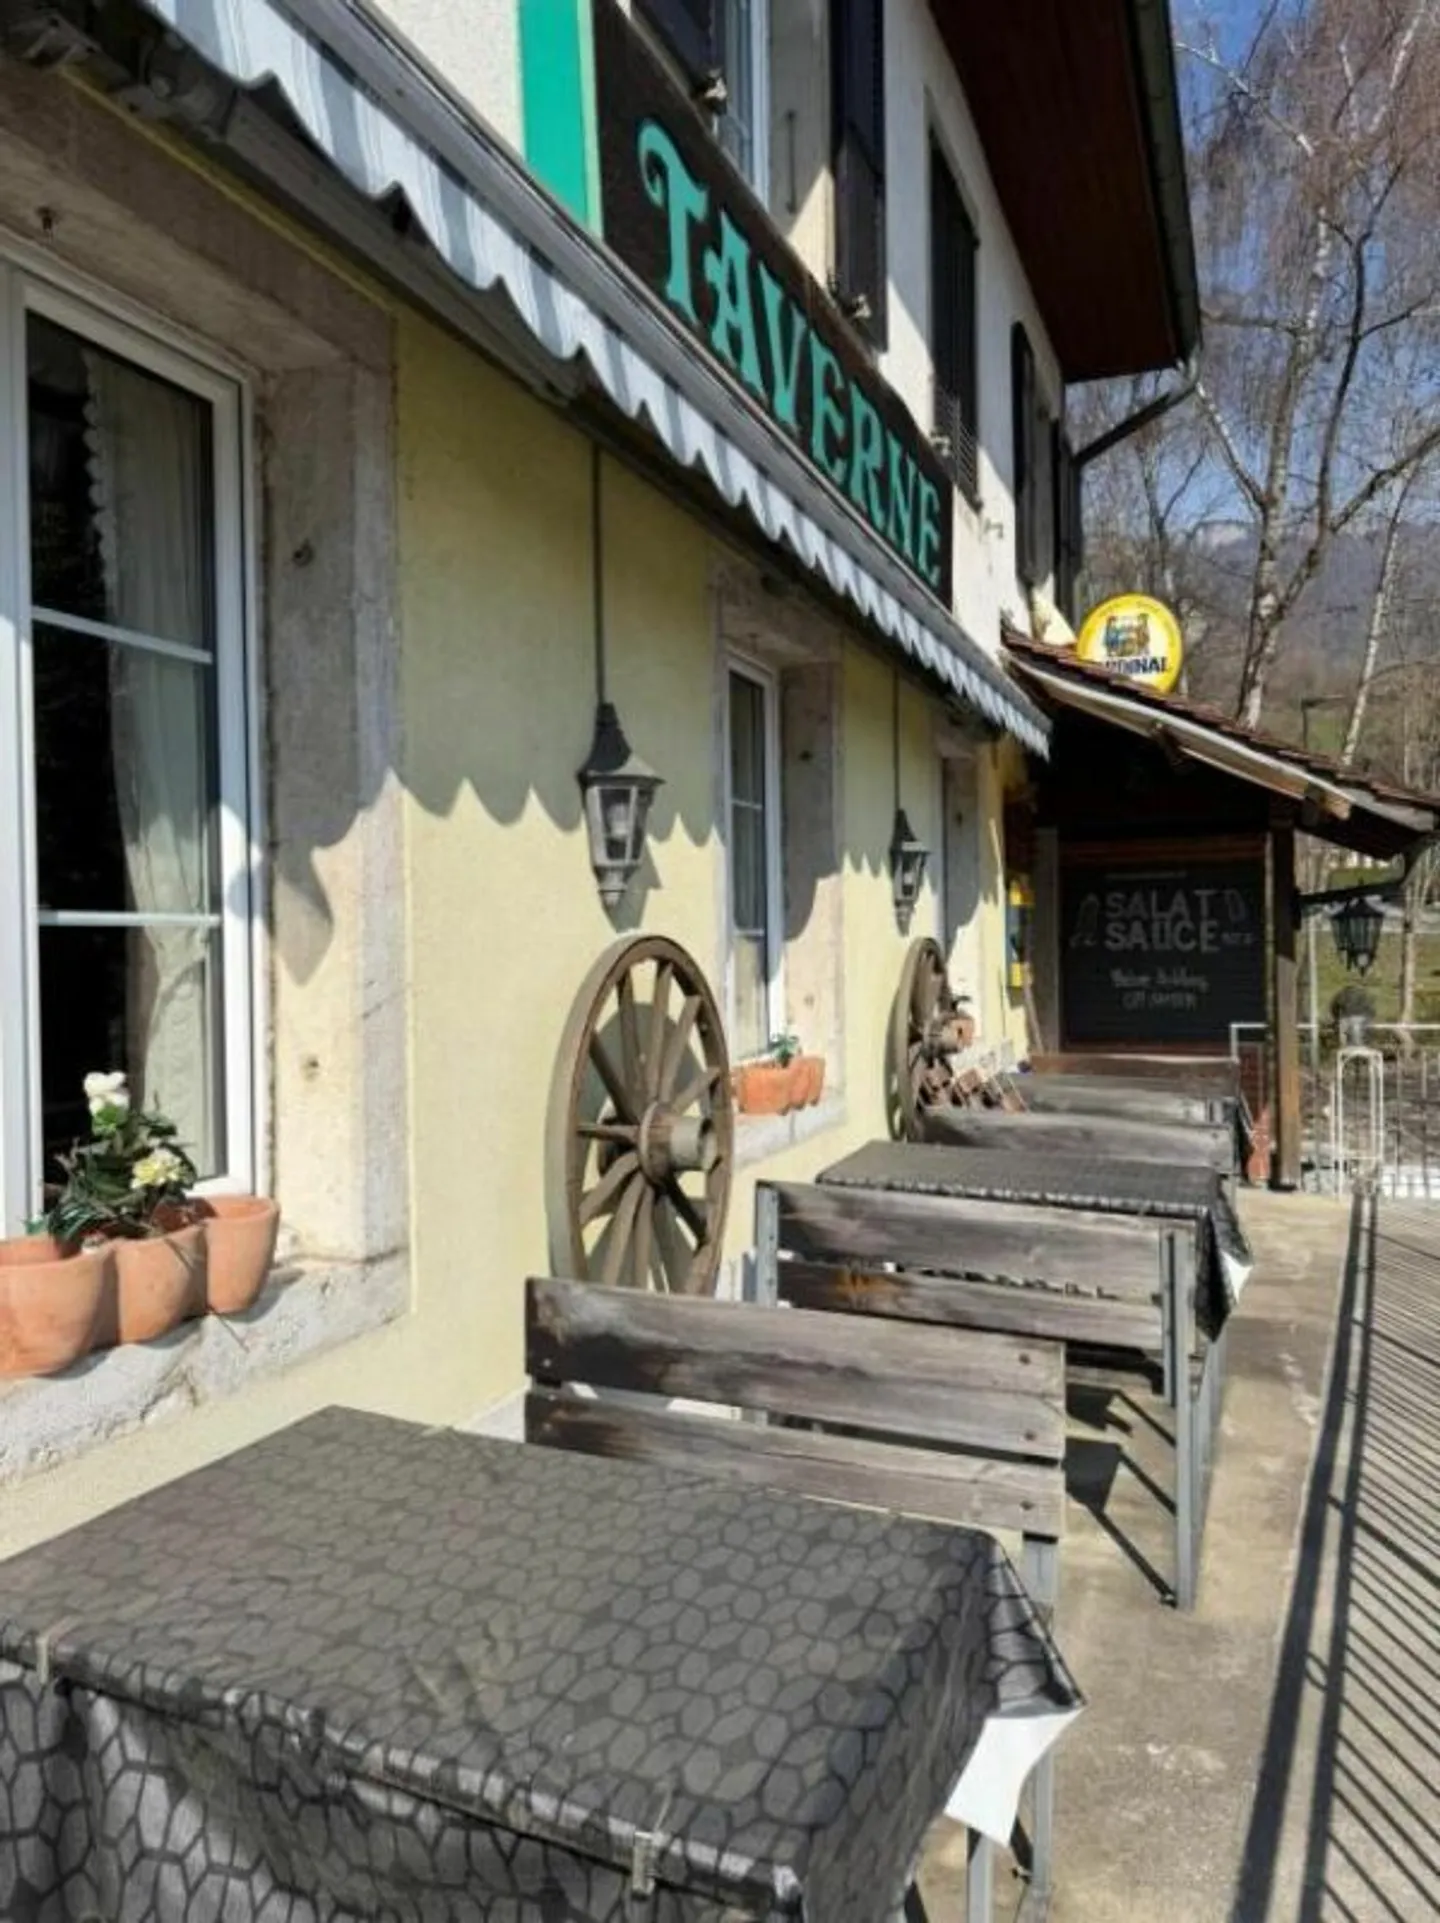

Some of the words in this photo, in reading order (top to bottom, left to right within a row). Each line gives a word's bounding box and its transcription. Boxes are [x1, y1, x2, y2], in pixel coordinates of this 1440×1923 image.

[638, 117, 942, 588] TAVERNE
[1104, 888, 1218, 921] SALAT
[1104, 919, 1221, 955] SAUCE
